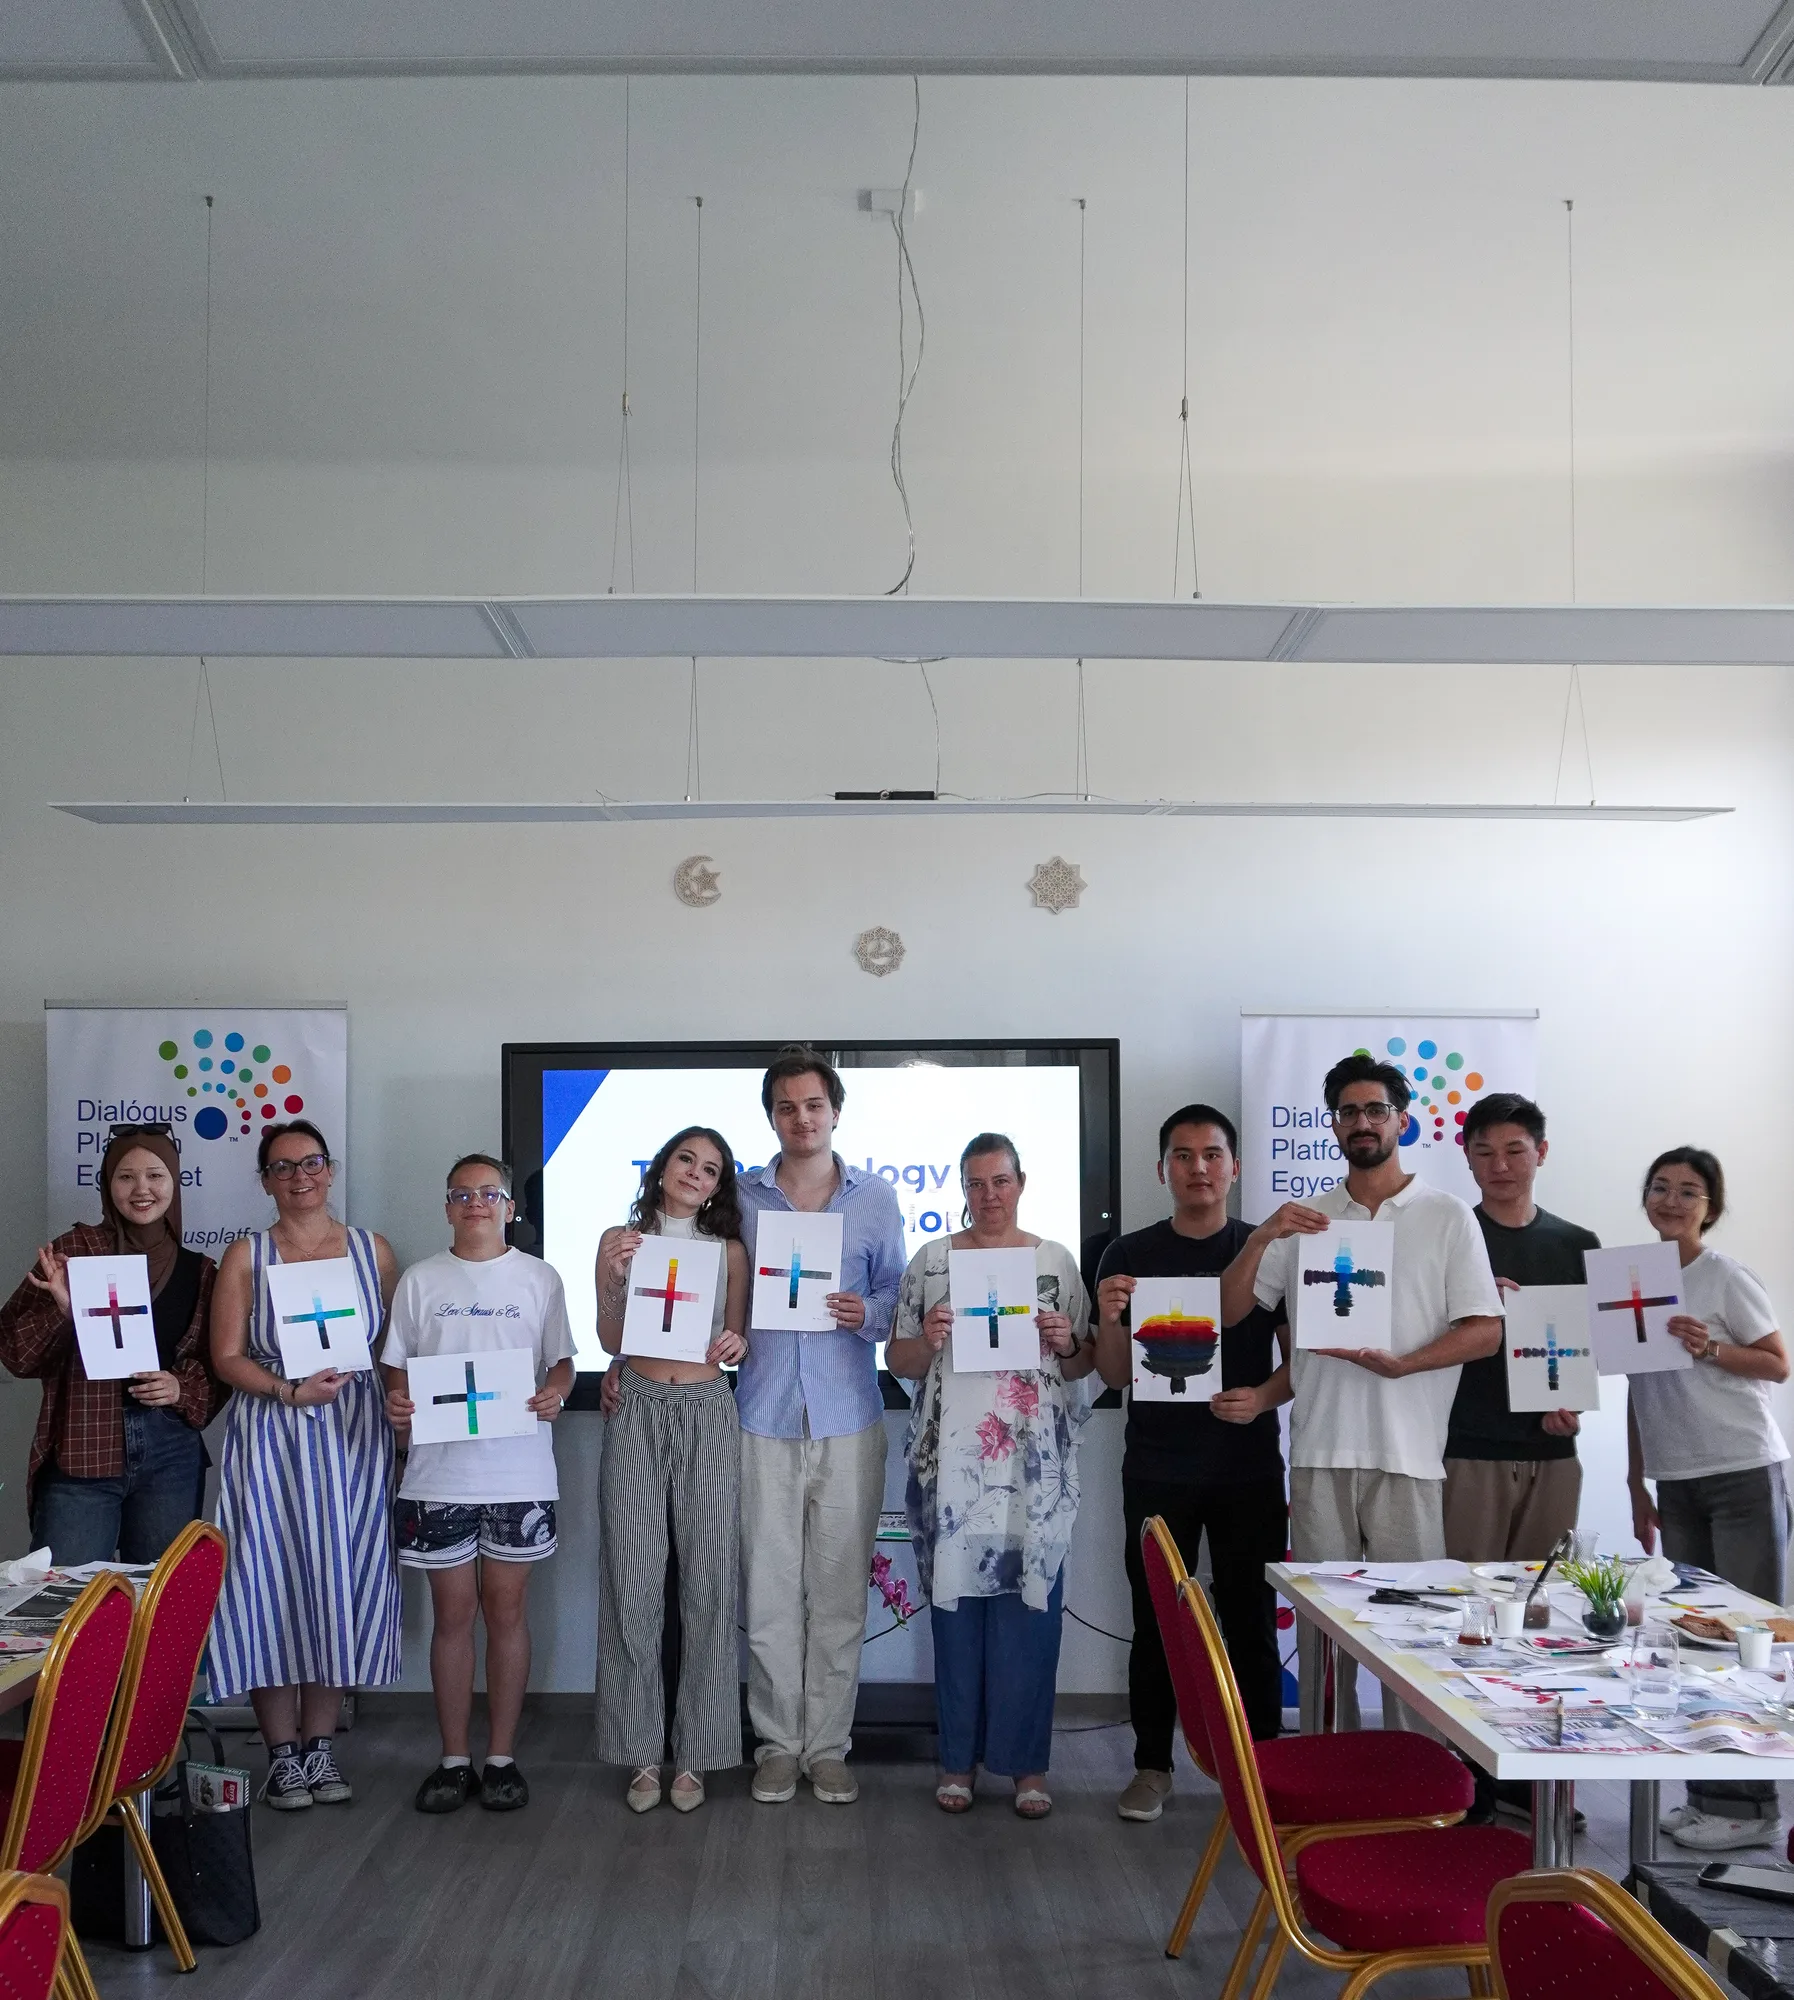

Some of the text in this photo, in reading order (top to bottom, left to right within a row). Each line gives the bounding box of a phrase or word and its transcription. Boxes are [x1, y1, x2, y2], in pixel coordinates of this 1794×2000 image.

[77, 1099, 188, 1123] Dialógus
[1272, 1138, 1347, 1160] Platfo
[434, 1302, 521, 1319] Levi Strauss & Co.
